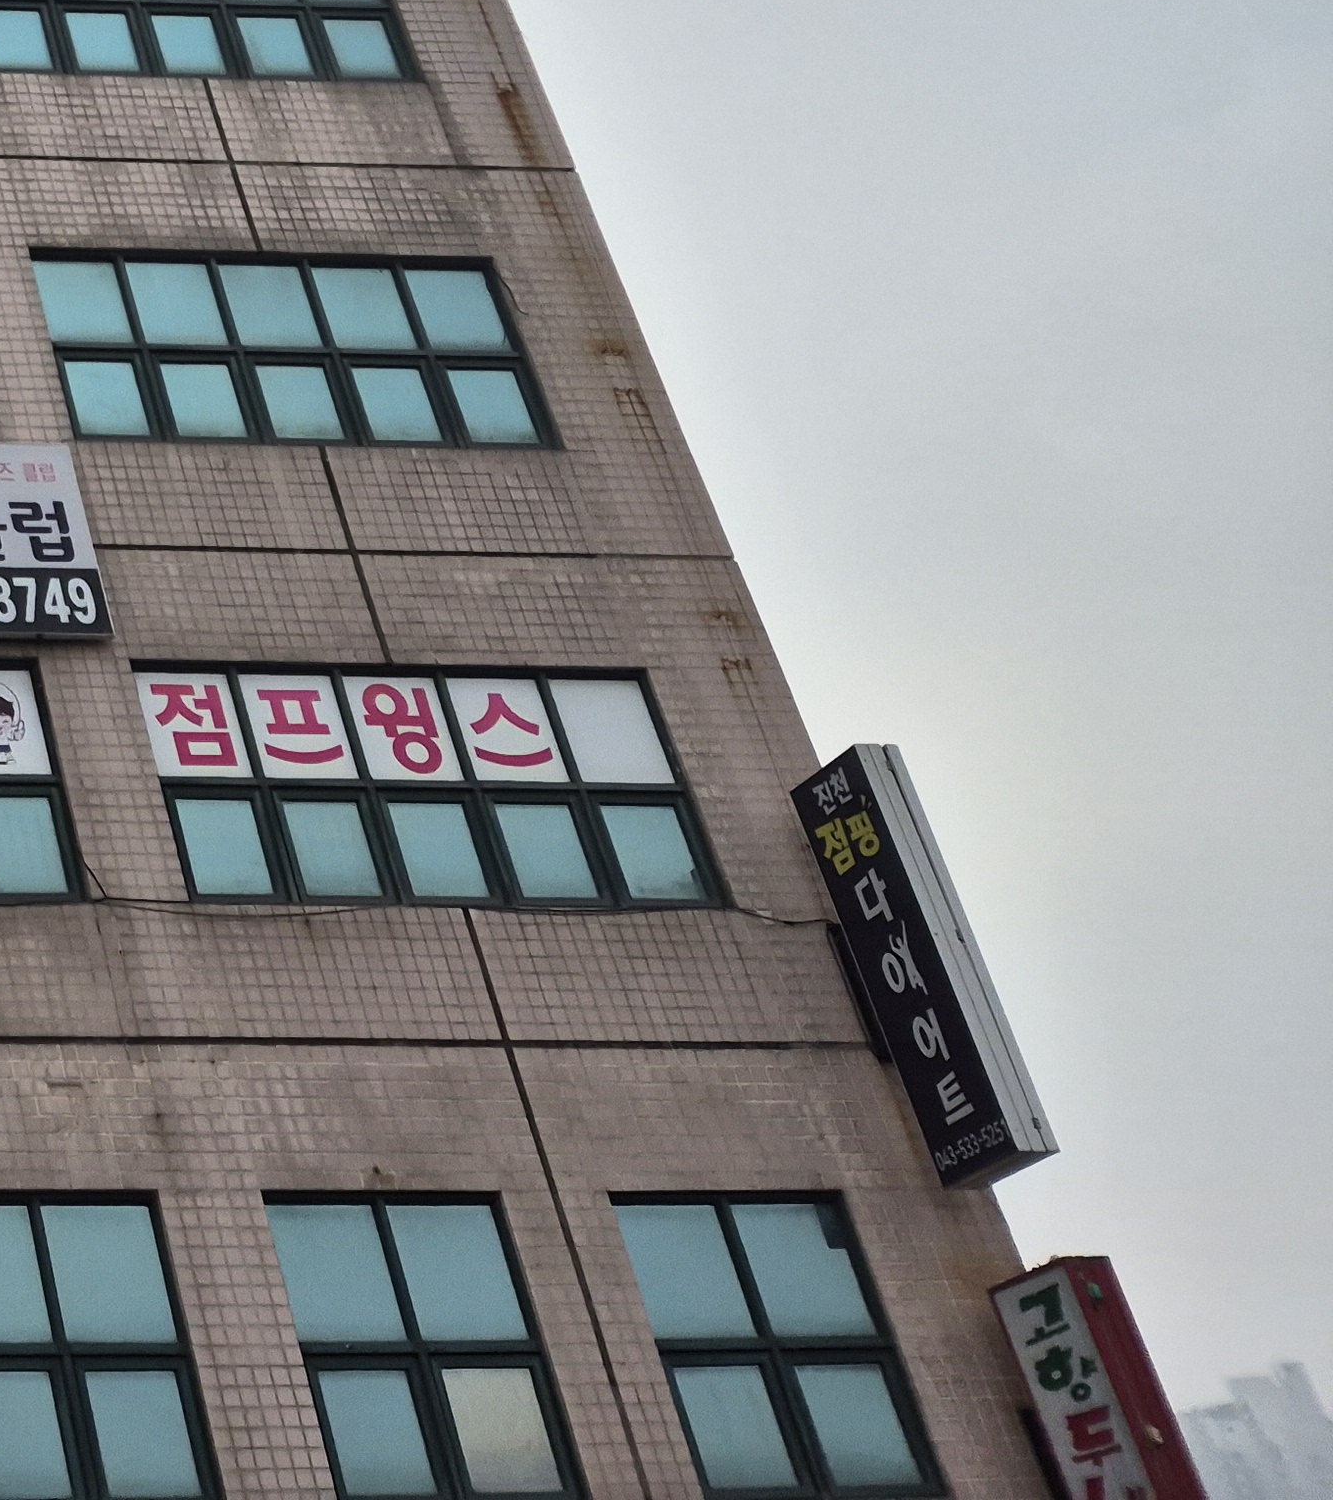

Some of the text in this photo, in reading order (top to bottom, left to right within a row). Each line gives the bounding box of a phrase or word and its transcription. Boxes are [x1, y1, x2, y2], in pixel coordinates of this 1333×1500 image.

[150, 683, 554, 775] 점프윙스
[812, 766, 853, 815] 진천
[815, 807, 881, 876] 점핑
[935, 1117, 1013, 1172] 043-533-5251
